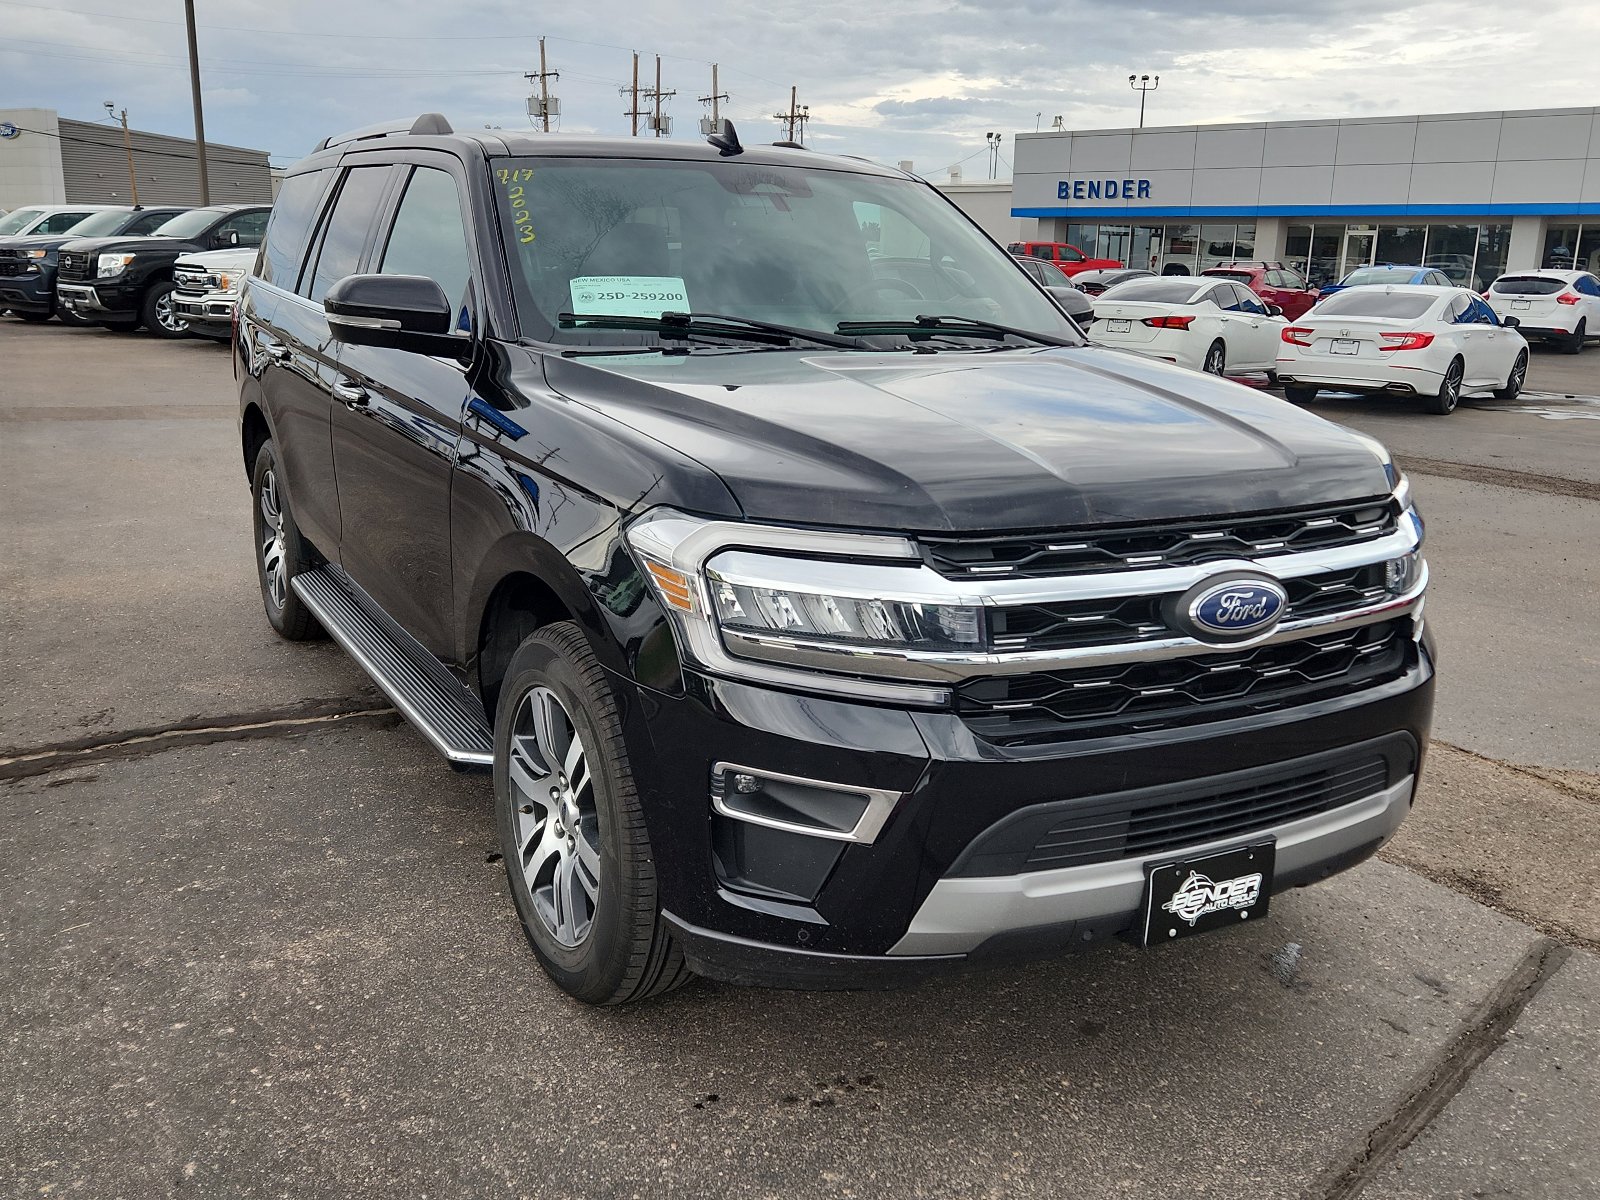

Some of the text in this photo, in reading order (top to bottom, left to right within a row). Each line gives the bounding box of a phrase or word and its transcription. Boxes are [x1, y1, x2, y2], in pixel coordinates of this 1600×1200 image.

[1057, 179, 1152, 199] BENDER
[597, 292, 683, 301] 25D-259200
[1216, 591, 1267, 624] Ford
[1171, 875, 1261, 911] BENDER
[1203, 898, 1229, 911] AUTO
